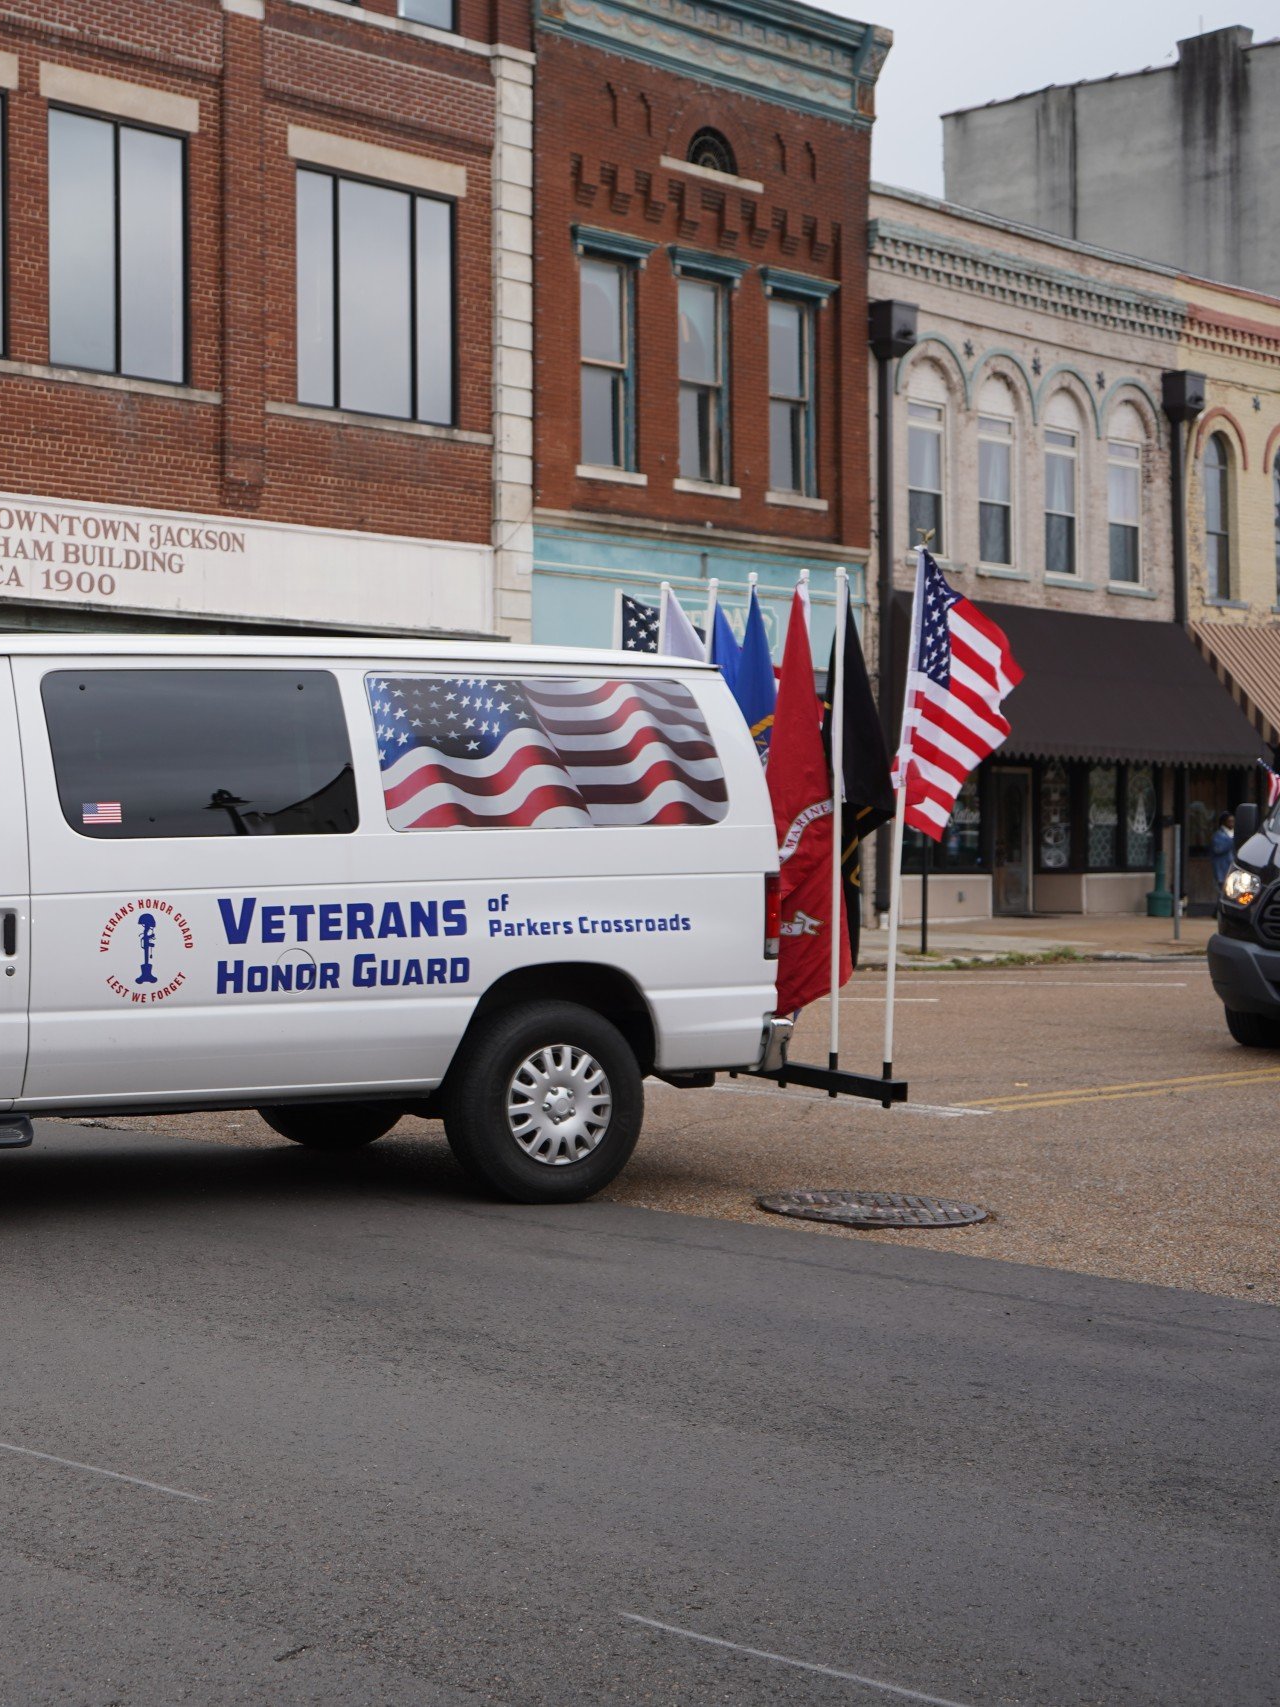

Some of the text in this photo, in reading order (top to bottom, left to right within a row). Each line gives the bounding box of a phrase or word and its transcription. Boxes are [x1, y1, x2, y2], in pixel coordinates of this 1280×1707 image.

[149, 523, 246, 553] JACKSON
[61, 542, 185, 574] BUILDING
[41, 568, 116, 596] 1900
[785, 802, 830, 850] MARINE
[487, 893, 510, 912] of
[100, 899, 194, 952] VETERANS HONOR GUARD
[489, 914, 692, 937] Parkers Crossroads
[106, 972, 186, 1003] LEST WE FORGET
